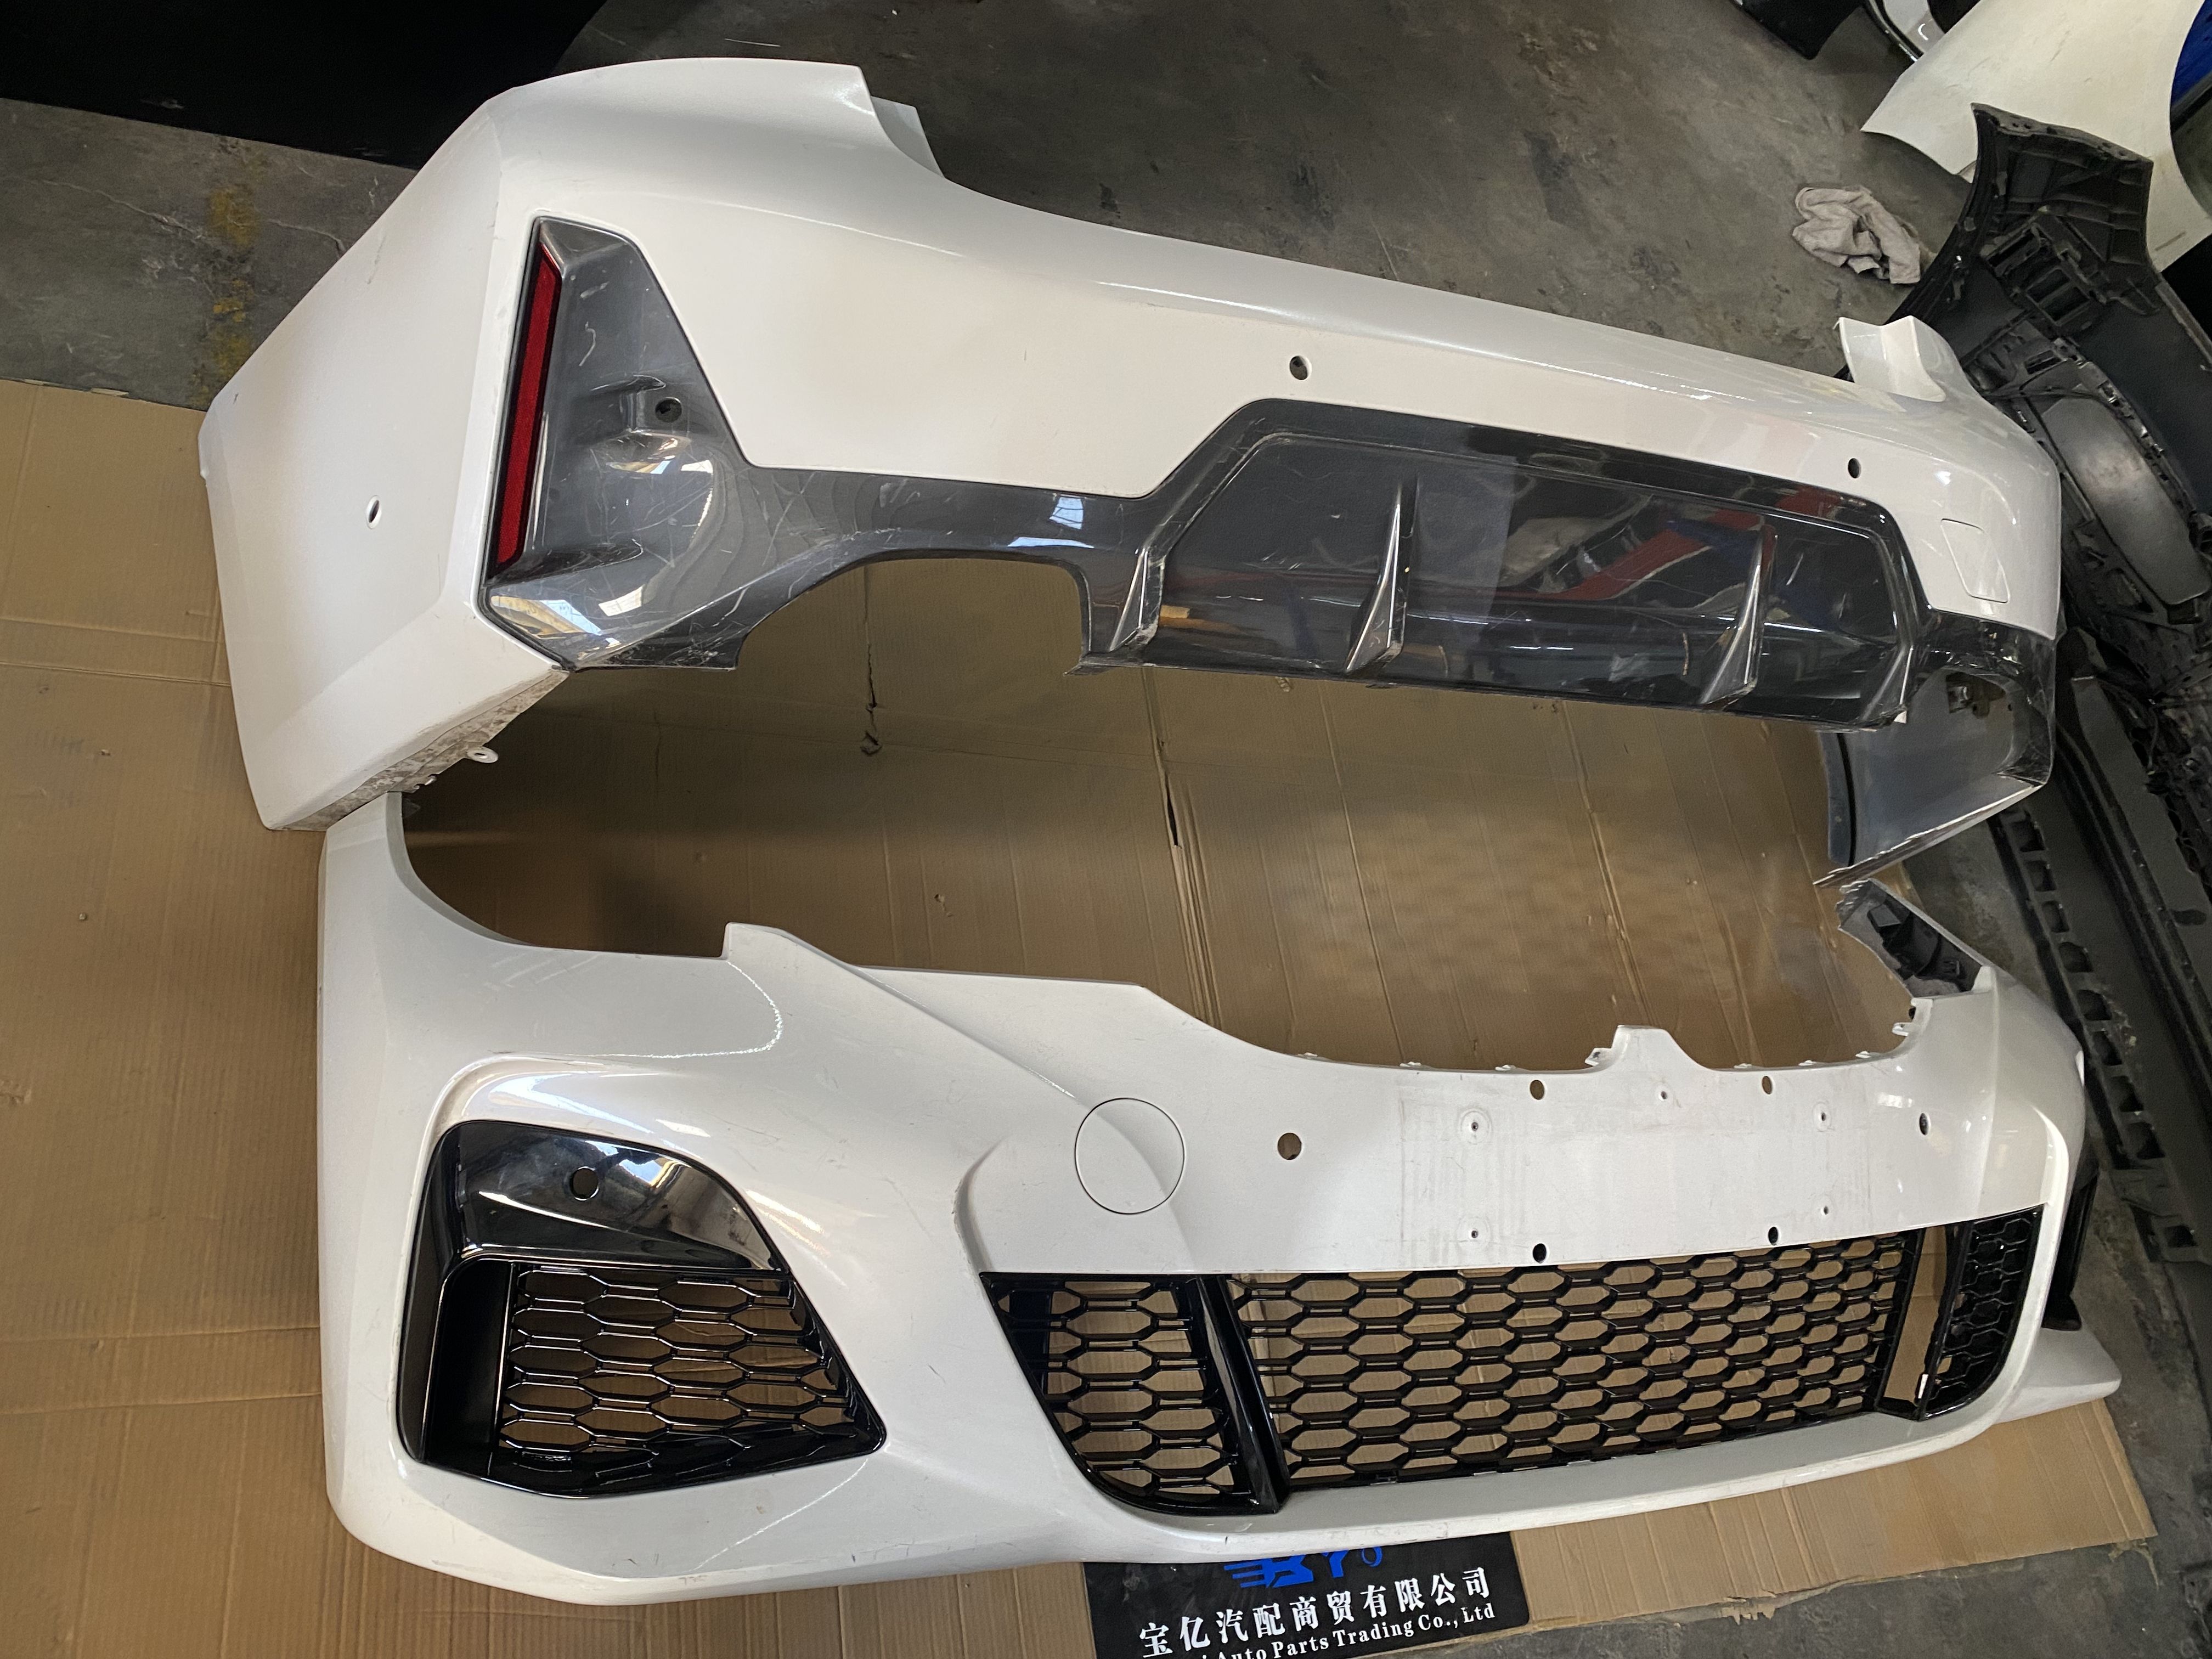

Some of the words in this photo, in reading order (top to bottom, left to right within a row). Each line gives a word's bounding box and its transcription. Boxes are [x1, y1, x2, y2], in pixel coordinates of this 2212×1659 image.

[1139, 1567, 1489, 1658] 宝亿汽配商贸有限公司
[1271, 1637, 1329, 1658] Parts
[1332, 1620, 1414, 1647] Trading
[1460, 1602, 1496, 1623] Ltd
